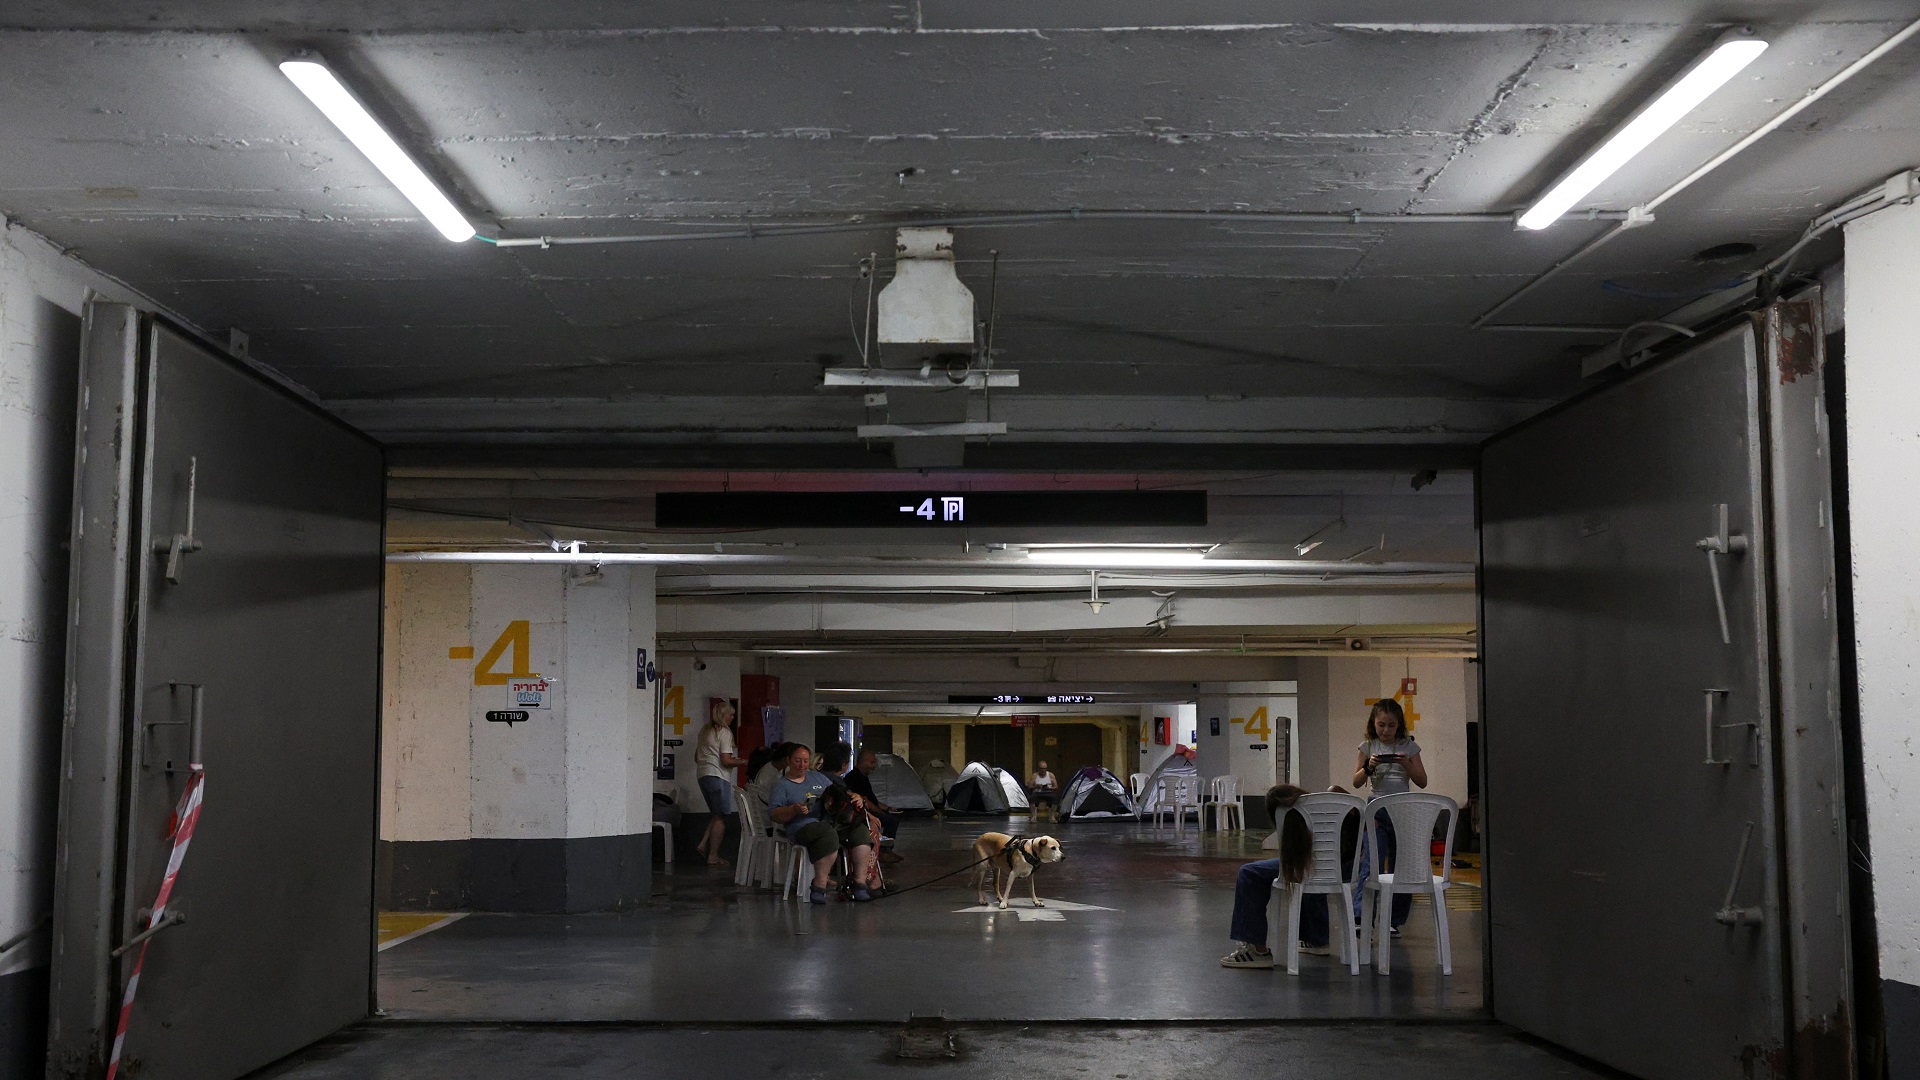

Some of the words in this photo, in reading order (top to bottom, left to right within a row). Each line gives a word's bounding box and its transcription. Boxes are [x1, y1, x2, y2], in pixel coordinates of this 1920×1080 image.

[899, 497, 936, 521] -4
[449, 620, 541, 686] -4
[516, 691, 542, 702] Wolt
[993, 695, 1004, 703] -3
[1058, 695, 1084, 703] יציאה
[500, 712, 523, 720] שורה
[1230, 705, 1271, 741] -4
